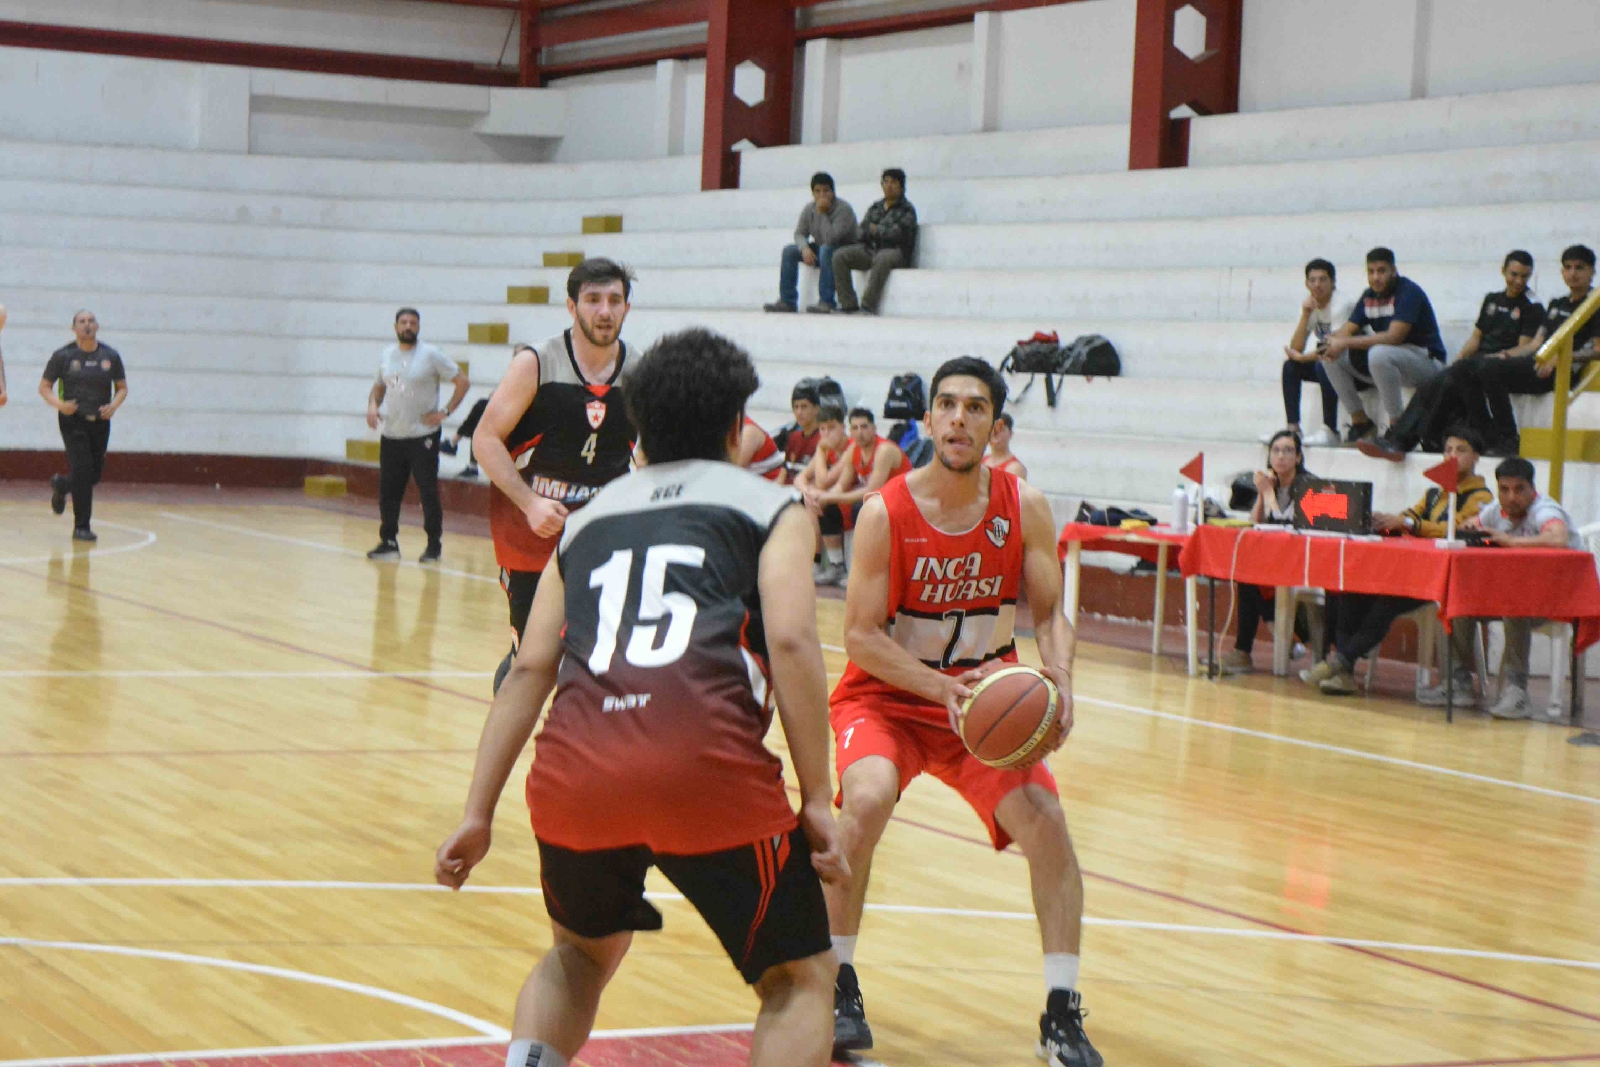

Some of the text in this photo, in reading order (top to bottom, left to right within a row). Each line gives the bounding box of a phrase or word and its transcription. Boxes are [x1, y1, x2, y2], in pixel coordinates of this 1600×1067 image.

[580, 433, 598, 465] 4
[911, 552, 982, 581] INCA
[919, 575, 1004, 604] HUASI
[588, 544, 706, 677] 15
[941, 608, 966, 670] 7
[844, 727, 854, 749] 7
